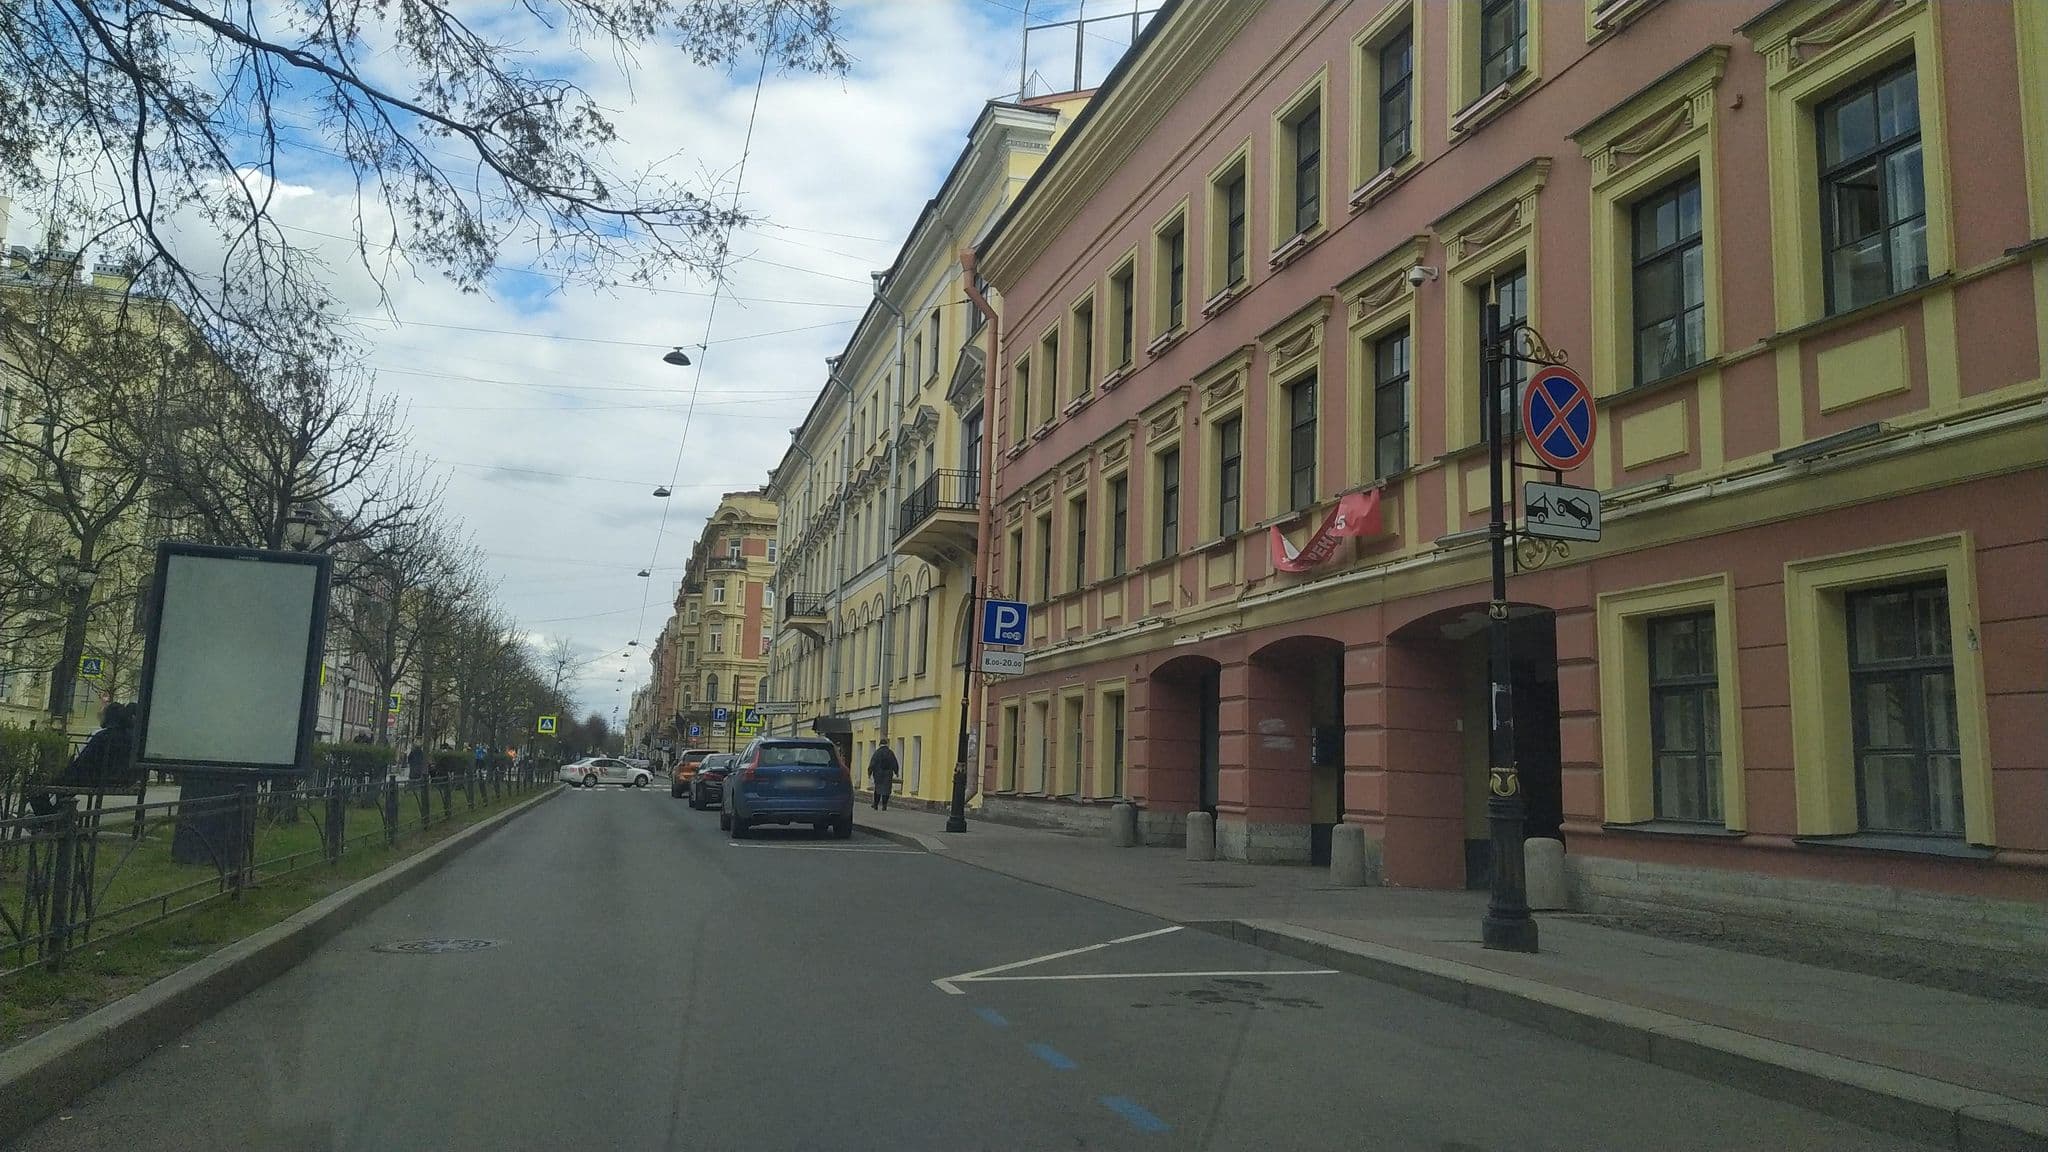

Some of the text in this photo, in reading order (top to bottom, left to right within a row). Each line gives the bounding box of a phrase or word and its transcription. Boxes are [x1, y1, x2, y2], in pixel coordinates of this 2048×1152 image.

[995, 606, 1019, 639] P
[716, 708, 725, 719] P
[691, 726, 698, 734] P
